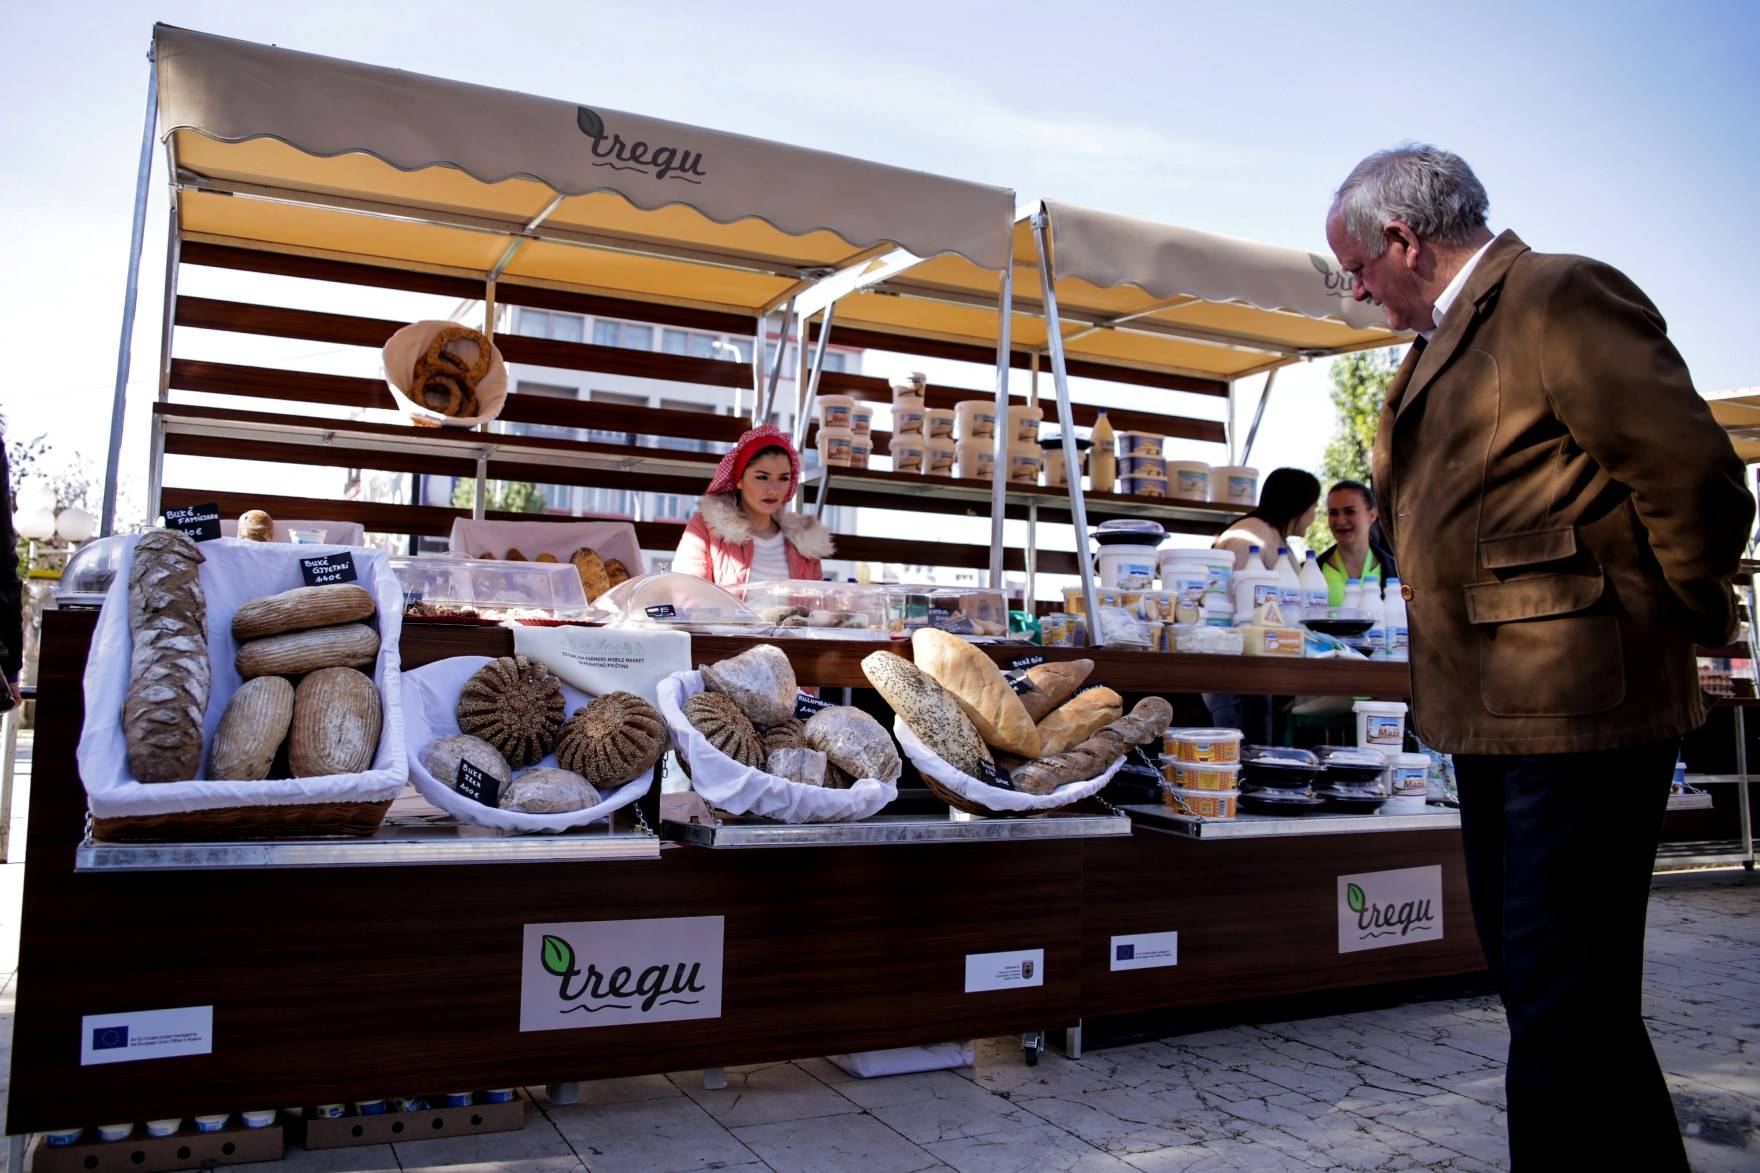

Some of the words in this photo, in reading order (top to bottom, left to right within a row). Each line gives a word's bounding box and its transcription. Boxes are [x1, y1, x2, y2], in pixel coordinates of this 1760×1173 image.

[590, 133, 706, 180] tregu
[1357, 898, 1435, 937] tregu
[558, 962, 706, 1013] tregu
